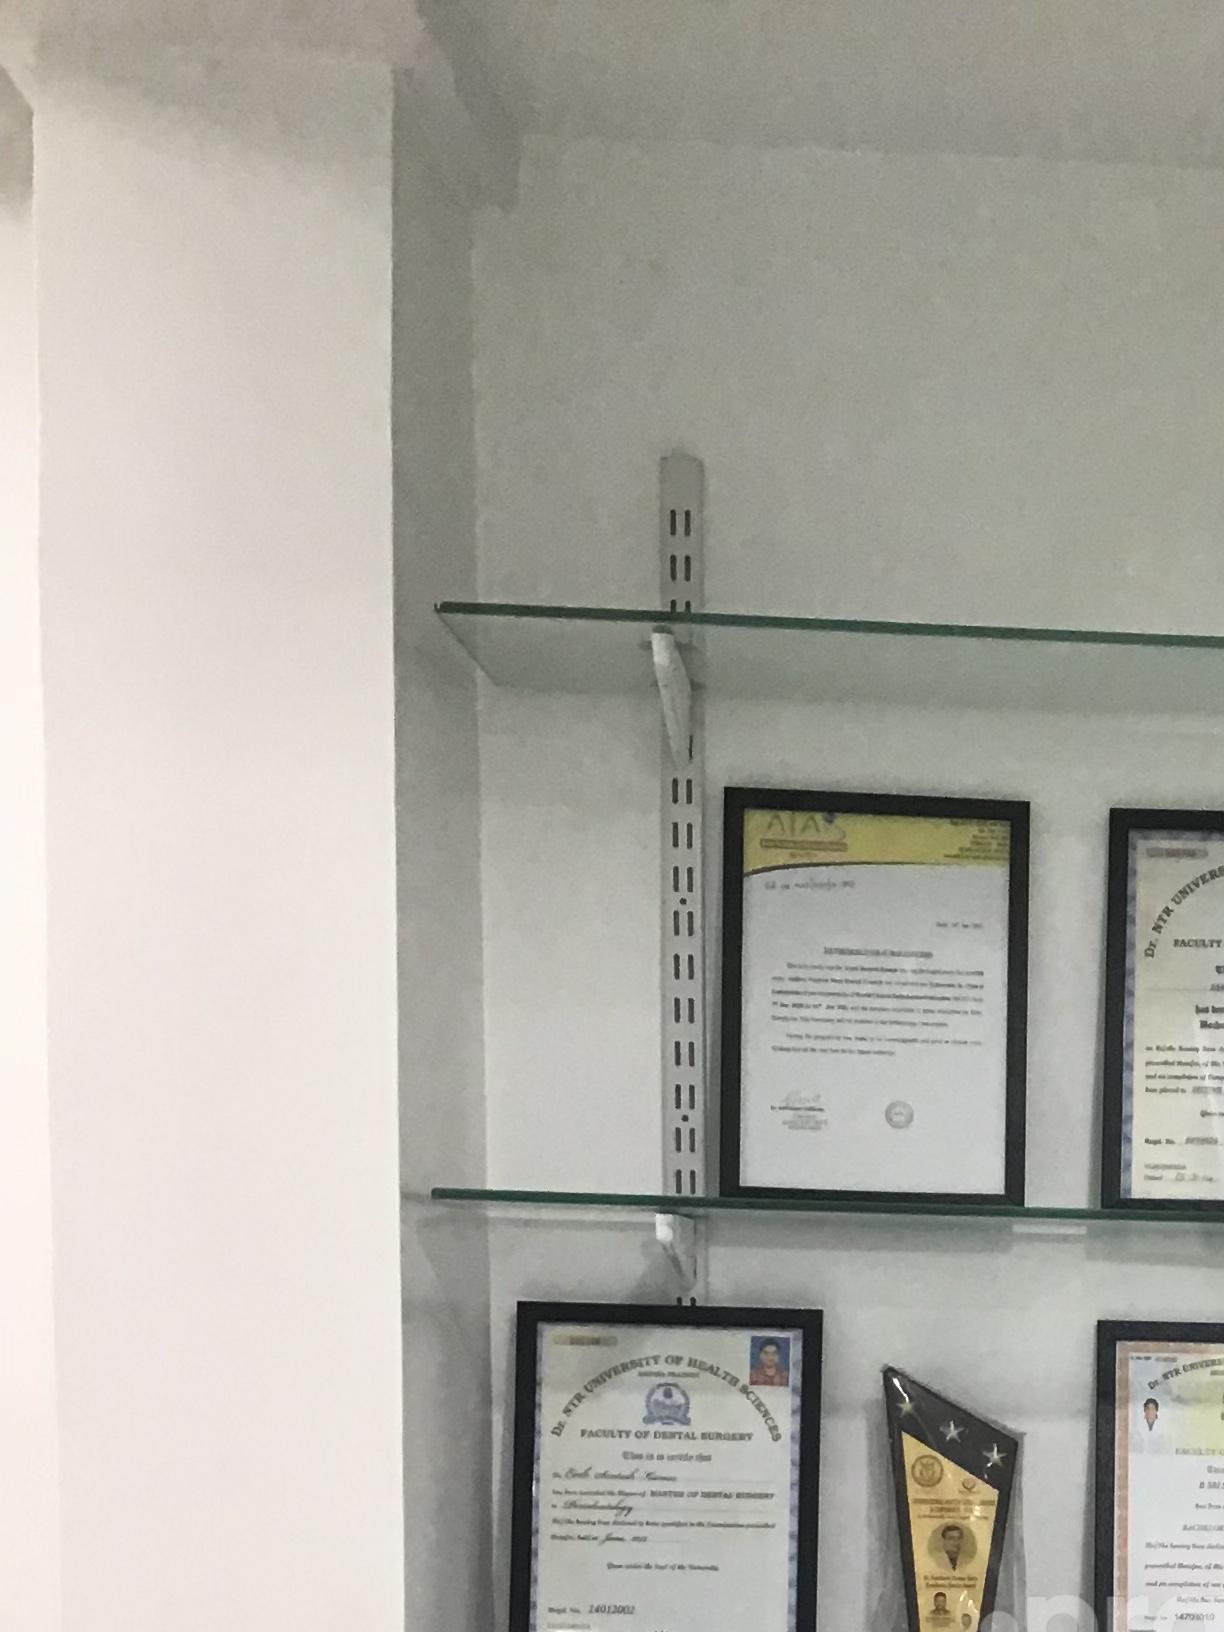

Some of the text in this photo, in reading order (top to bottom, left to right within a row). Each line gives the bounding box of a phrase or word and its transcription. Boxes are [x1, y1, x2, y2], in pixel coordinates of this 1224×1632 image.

[1152, 906, 1174, 935] NTR
[1173, 939, 1222, 949] FACULTY
[563, 1391, 586, 1417] NTR
[583, 1355, 661, 1393] UNIVERSITY
[665, 1355, 684, 1365] OF
[687, 1357, 740, 1387] HEALTH
[738, 1384, 782, 1442] SCIENCES
[580, 1429, 753, 1441] FACULTY OF DENTAL SURGERY
